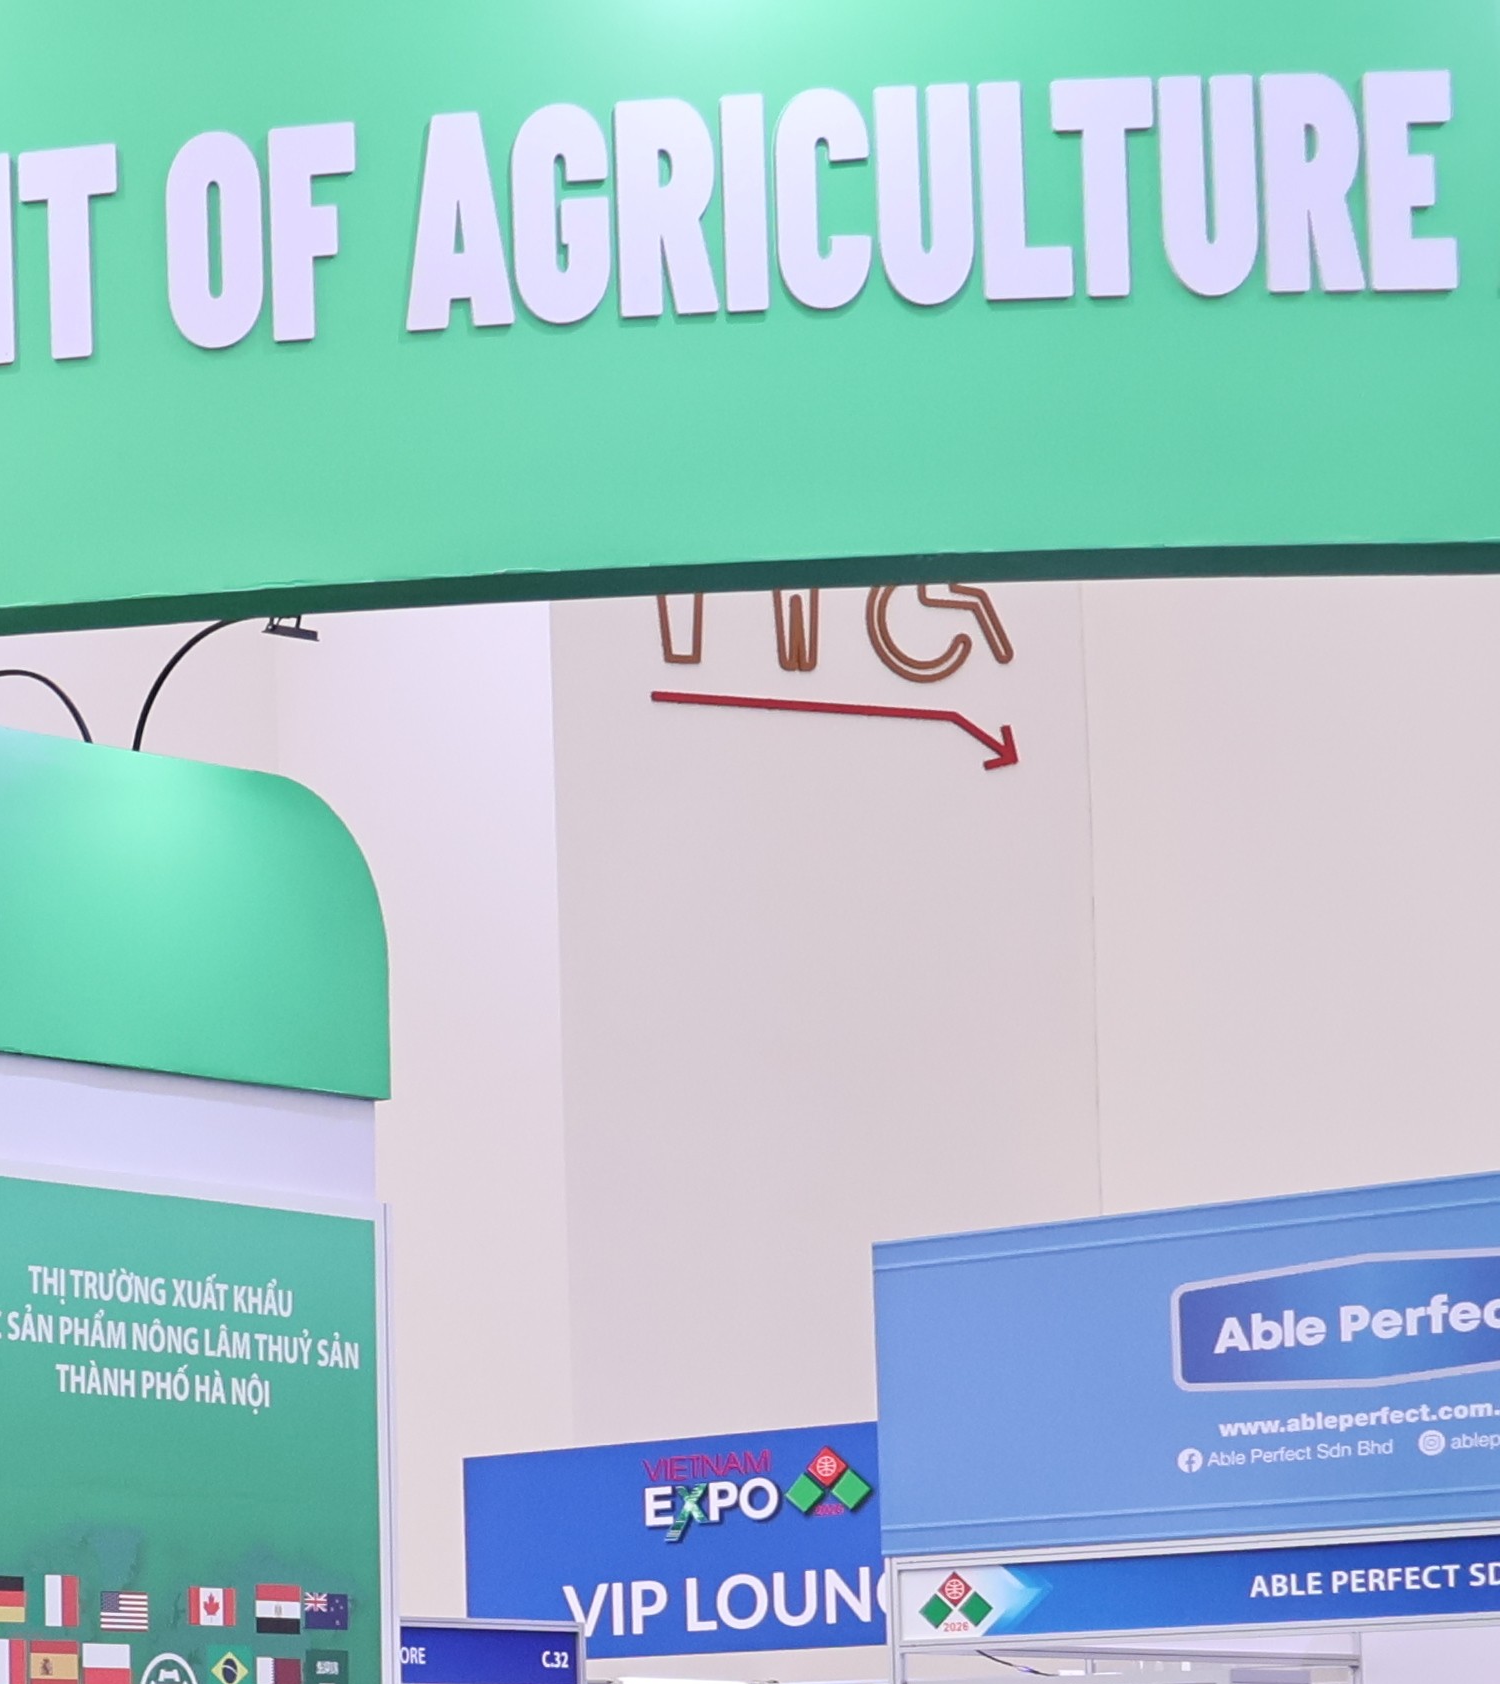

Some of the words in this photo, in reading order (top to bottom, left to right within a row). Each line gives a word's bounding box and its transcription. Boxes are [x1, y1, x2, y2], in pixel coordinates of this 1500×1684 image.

[165, 121, 356, 350] OF
[405, 68, 1460, 334] AGRICULTURE
[28, 1265, 66, 1305] THỊ
[70, 1267, 167, 1307] TRƯỜNG
[171, 1273, 229, 1313] XUẤT
[233, 1278, 294, 1319] KHẨU
[7, 1307, 54, 1344] SẢN
[59, 1310, 128, 1351] PHẨM
[132, 1318, 200, 1356] NÔNG
[204, 1324, 252, 1361] LÂM
[254, 1328, 313, 1366] THUỶ
[317, 1333, 360, 1370] SẢN
[1213, 1310, 1328, 1355] Able
[56, 1360, 136, 1399] THÀNH
[141, 1366, 190, 1403] PHỐ
[195, 1370, 227, 1406] HÀ
[231, 1373, 272, 1416] NỘI
[642, 1449, 772, 1482] VIETNAM
[1207, 1448, 1246, 1468] Able
[1250, 1444, 1311, 1465] Perfect
[1316, 1442, 1353, 1461] Sdn
[1356, 1439, 1393, 1458] Bhd
[644, 1476, 780, 1543] EXPO
[562, 1577, 669, 1638] VIP
[686, 1565, 887, 1633] LOUN
[1250, 1572, 1323, 1599] ABLE
[1331, 1563, 1460, 1595] PERFECT
[542, 1650, 569, 1668] C.32
